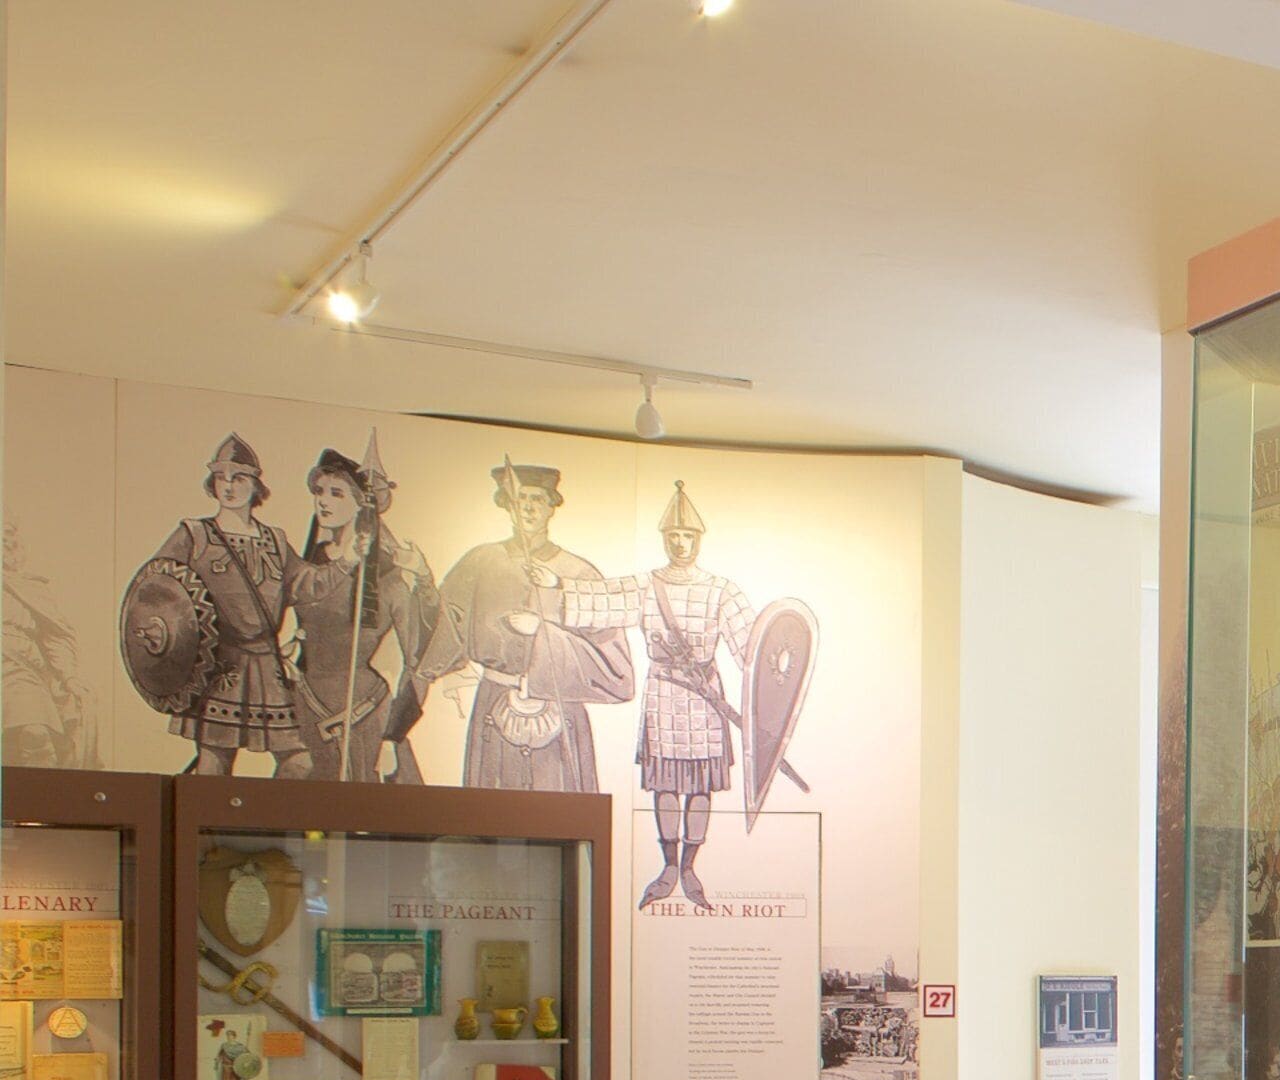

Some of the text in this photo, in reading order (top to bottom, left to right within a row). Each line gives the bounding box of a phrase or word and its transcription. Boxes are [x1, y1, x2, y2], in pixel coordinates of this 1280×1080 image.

[392, 903, 537, 921] THE PAGEANT
[649, 902, 787, 918] THE GUN RIOT
[929, 992, 951, 1009] 27
